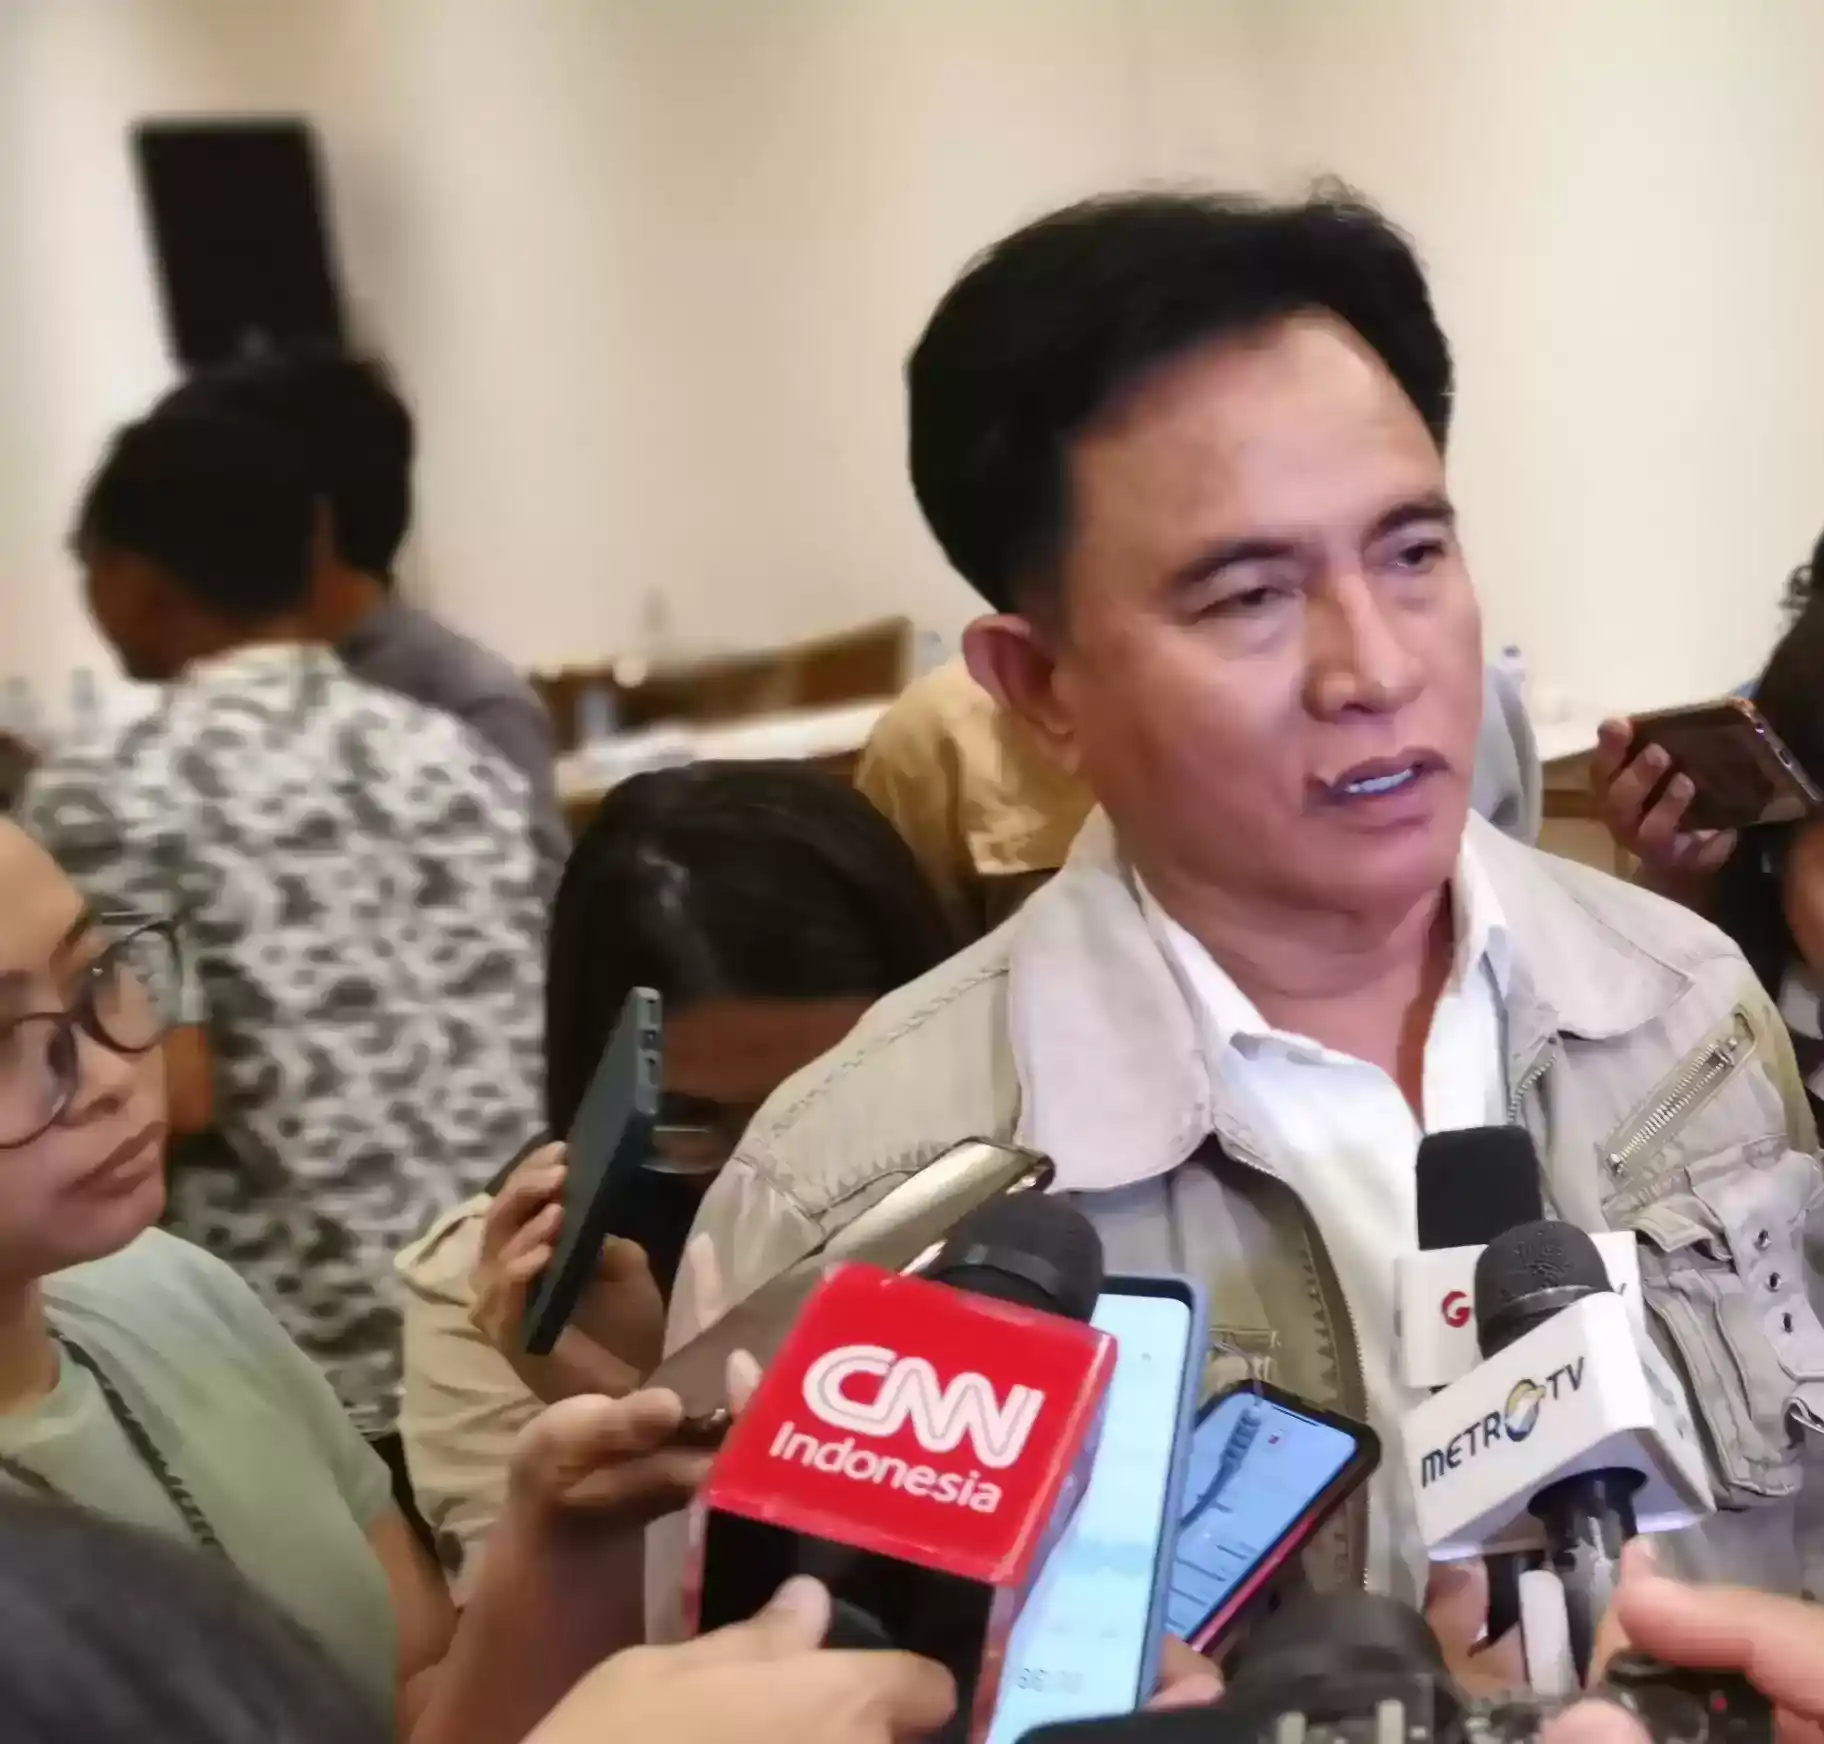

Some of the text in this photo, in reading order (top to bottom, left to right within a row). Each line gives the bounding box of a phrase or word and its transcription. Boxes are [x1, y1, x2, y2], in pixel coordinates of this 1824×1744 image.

[769, 1420, 1003, 1513] Indonesia
[802, 1344, 1046, 1469] CNN
[1420, 1378, 1542, 1488] METRO
[1546, 1356, 1584, 1401] TV
